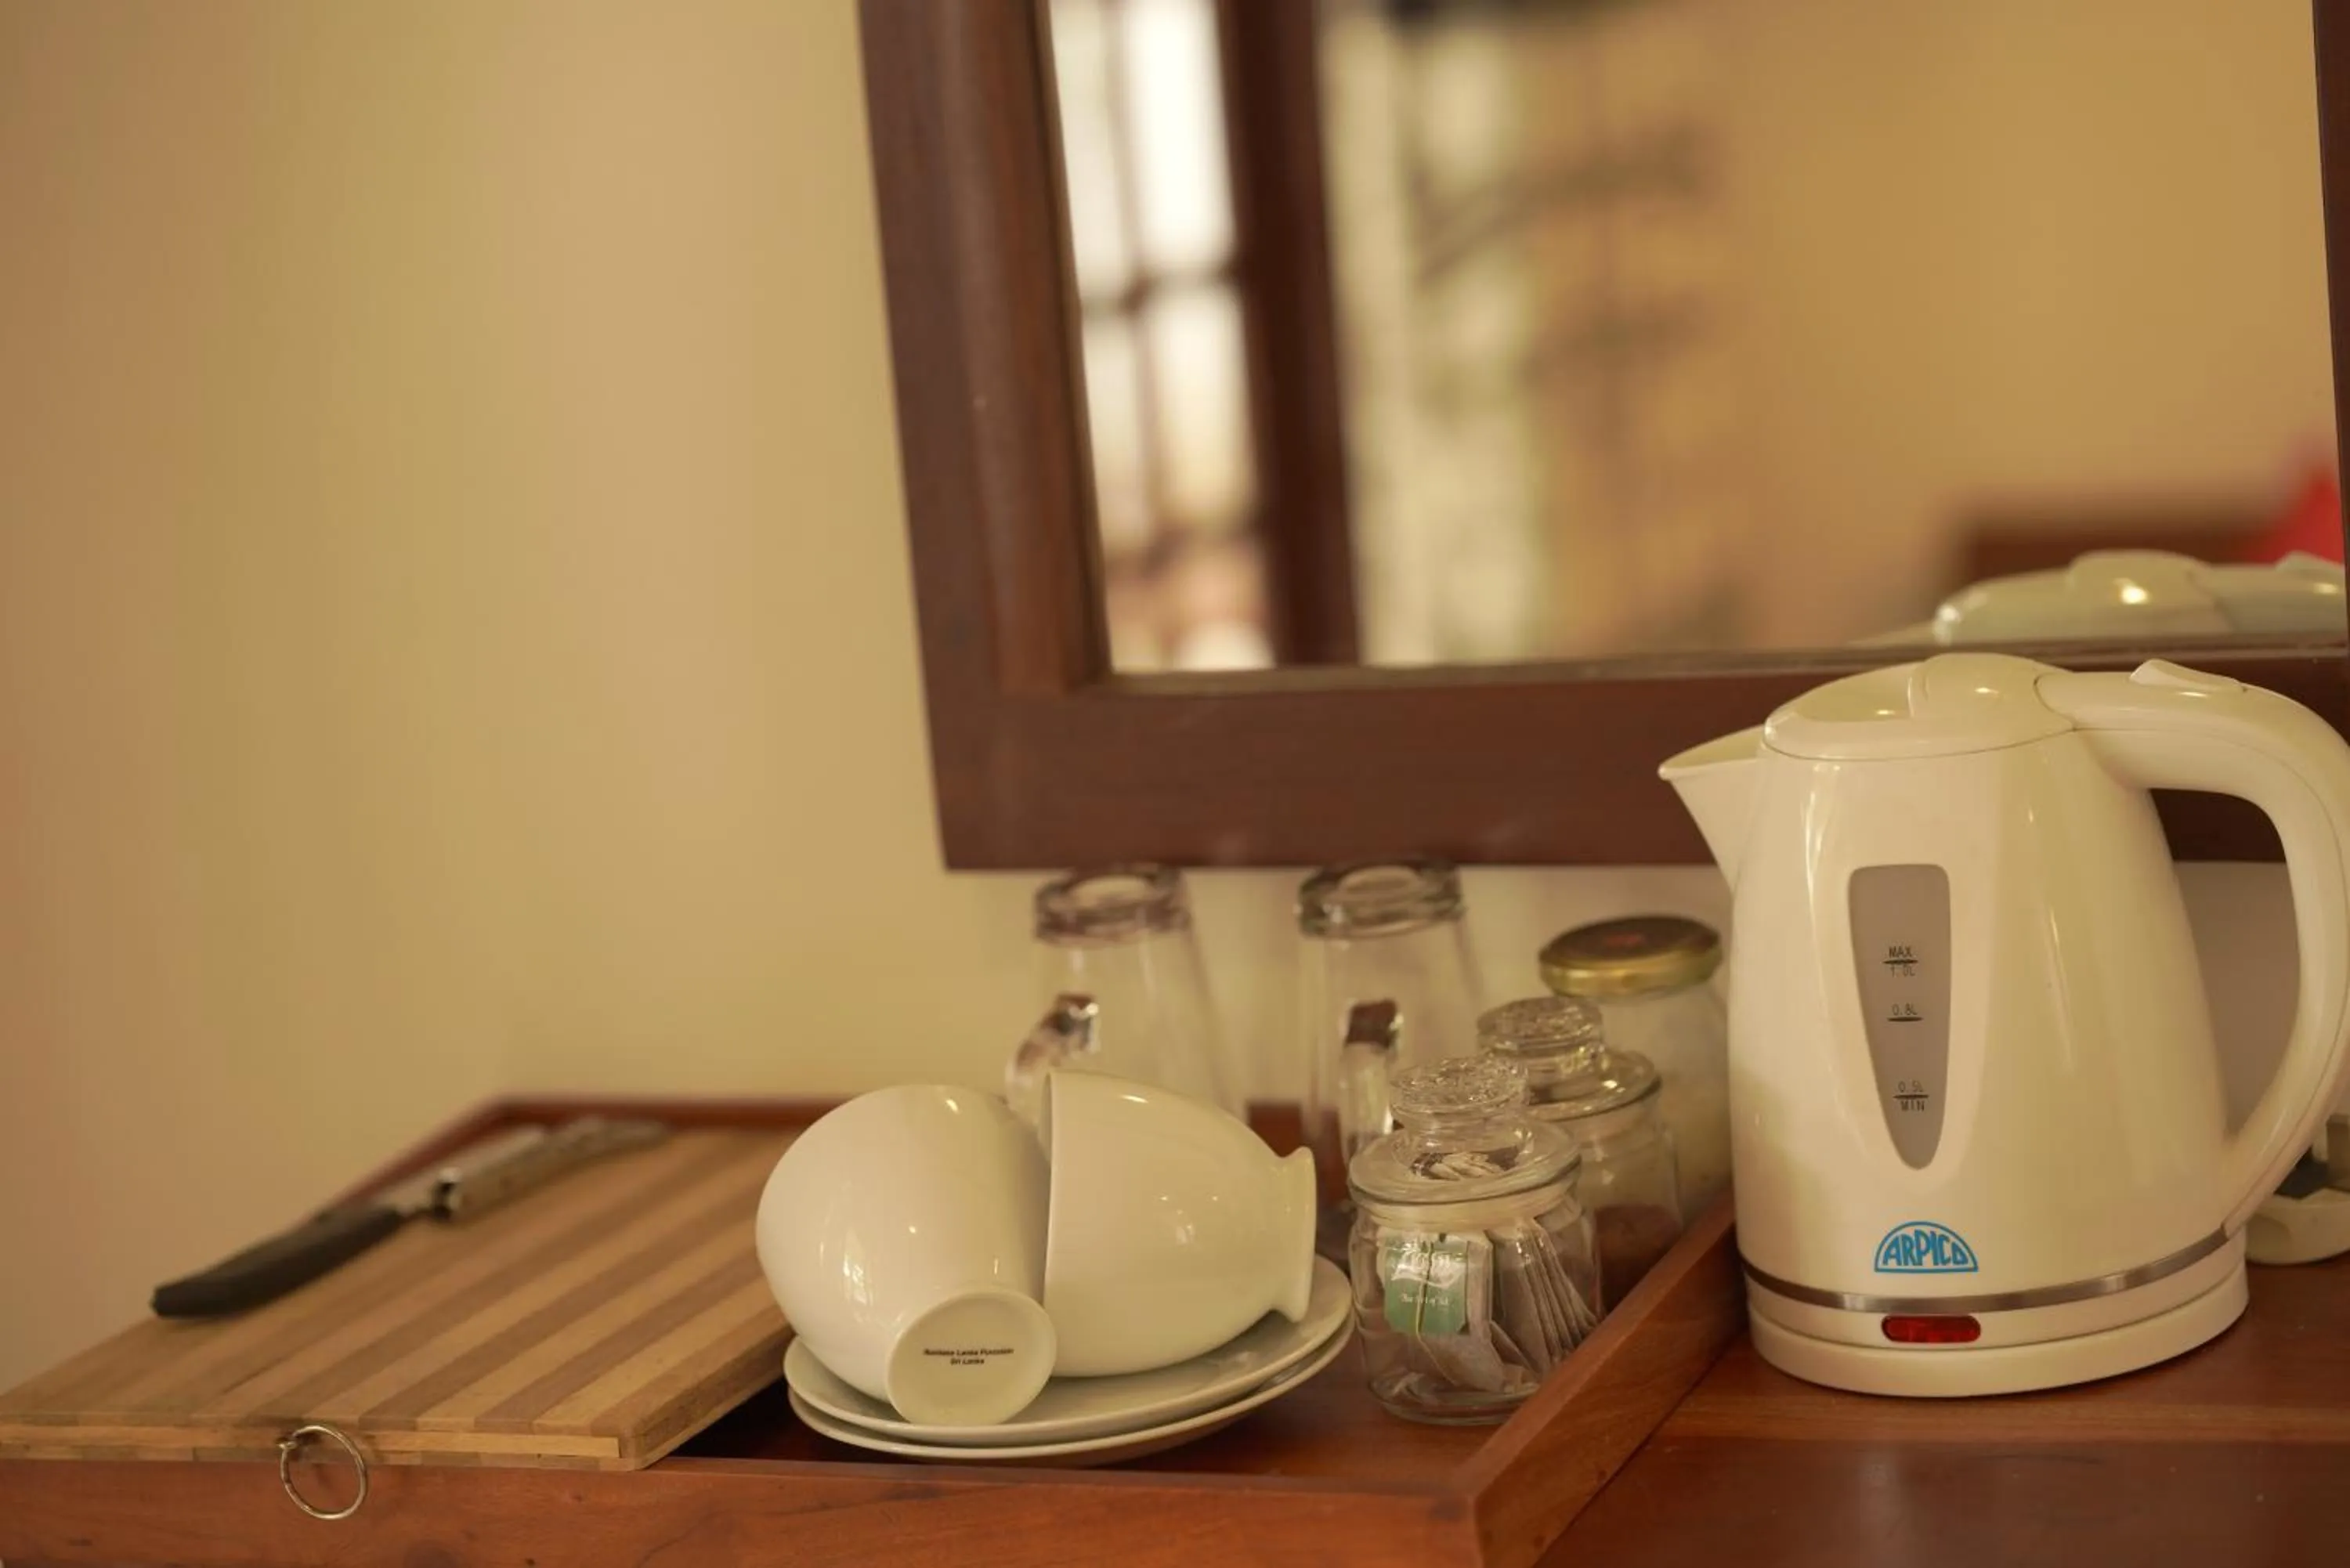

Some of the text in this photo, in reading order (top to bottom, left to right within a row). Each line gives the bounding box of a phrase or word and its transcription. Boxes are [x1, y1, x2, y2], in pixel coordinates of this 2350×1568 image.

[1889, 945, 1912, 957] MAX
[1892, 1003, 1918, 1016] 0.8L
[1901, 1100, 1925, 1111] MIN
